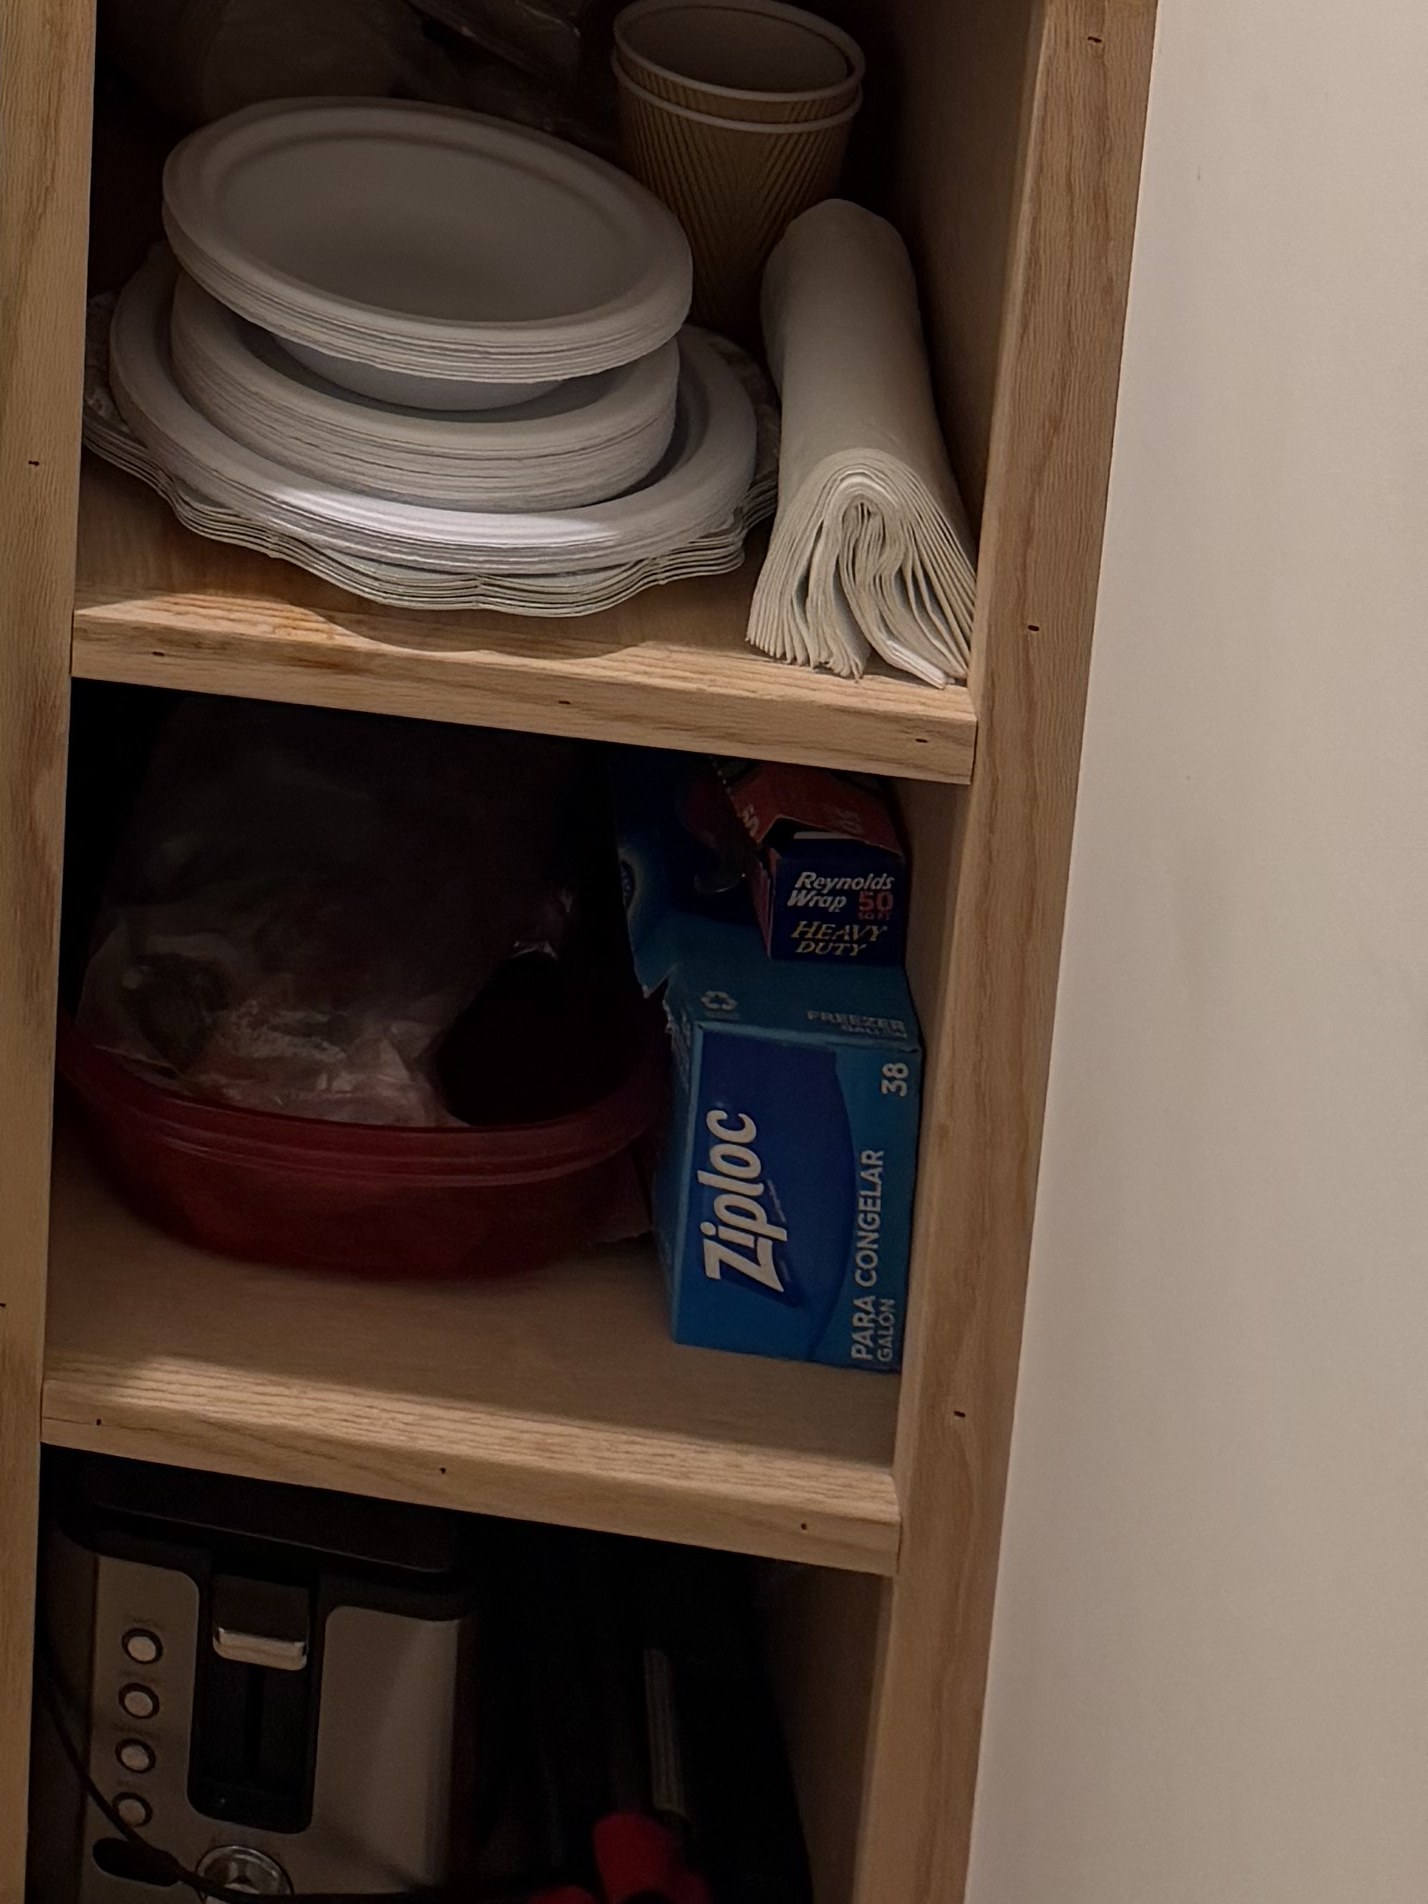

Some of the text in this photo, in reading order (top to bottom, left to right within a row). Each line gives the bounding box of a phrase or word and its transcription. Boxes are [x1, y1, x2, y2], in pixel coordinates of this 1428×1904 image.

[794, 871, 896, 893] Reynolds
[786, 890, 847, 913] Wrap
[858, 891, 894, 911] 50
[790, 921, 888, 941] HEAVY
[795, 941, 868, 956] DUTY
[807, 1009, 905, 1030] FREEZER
[882, 1062, 909, 1097] 38
[697, 1109, 787, 1293] Ziploc
[851, 1149, 884, 1360] PARA CONGELAR
